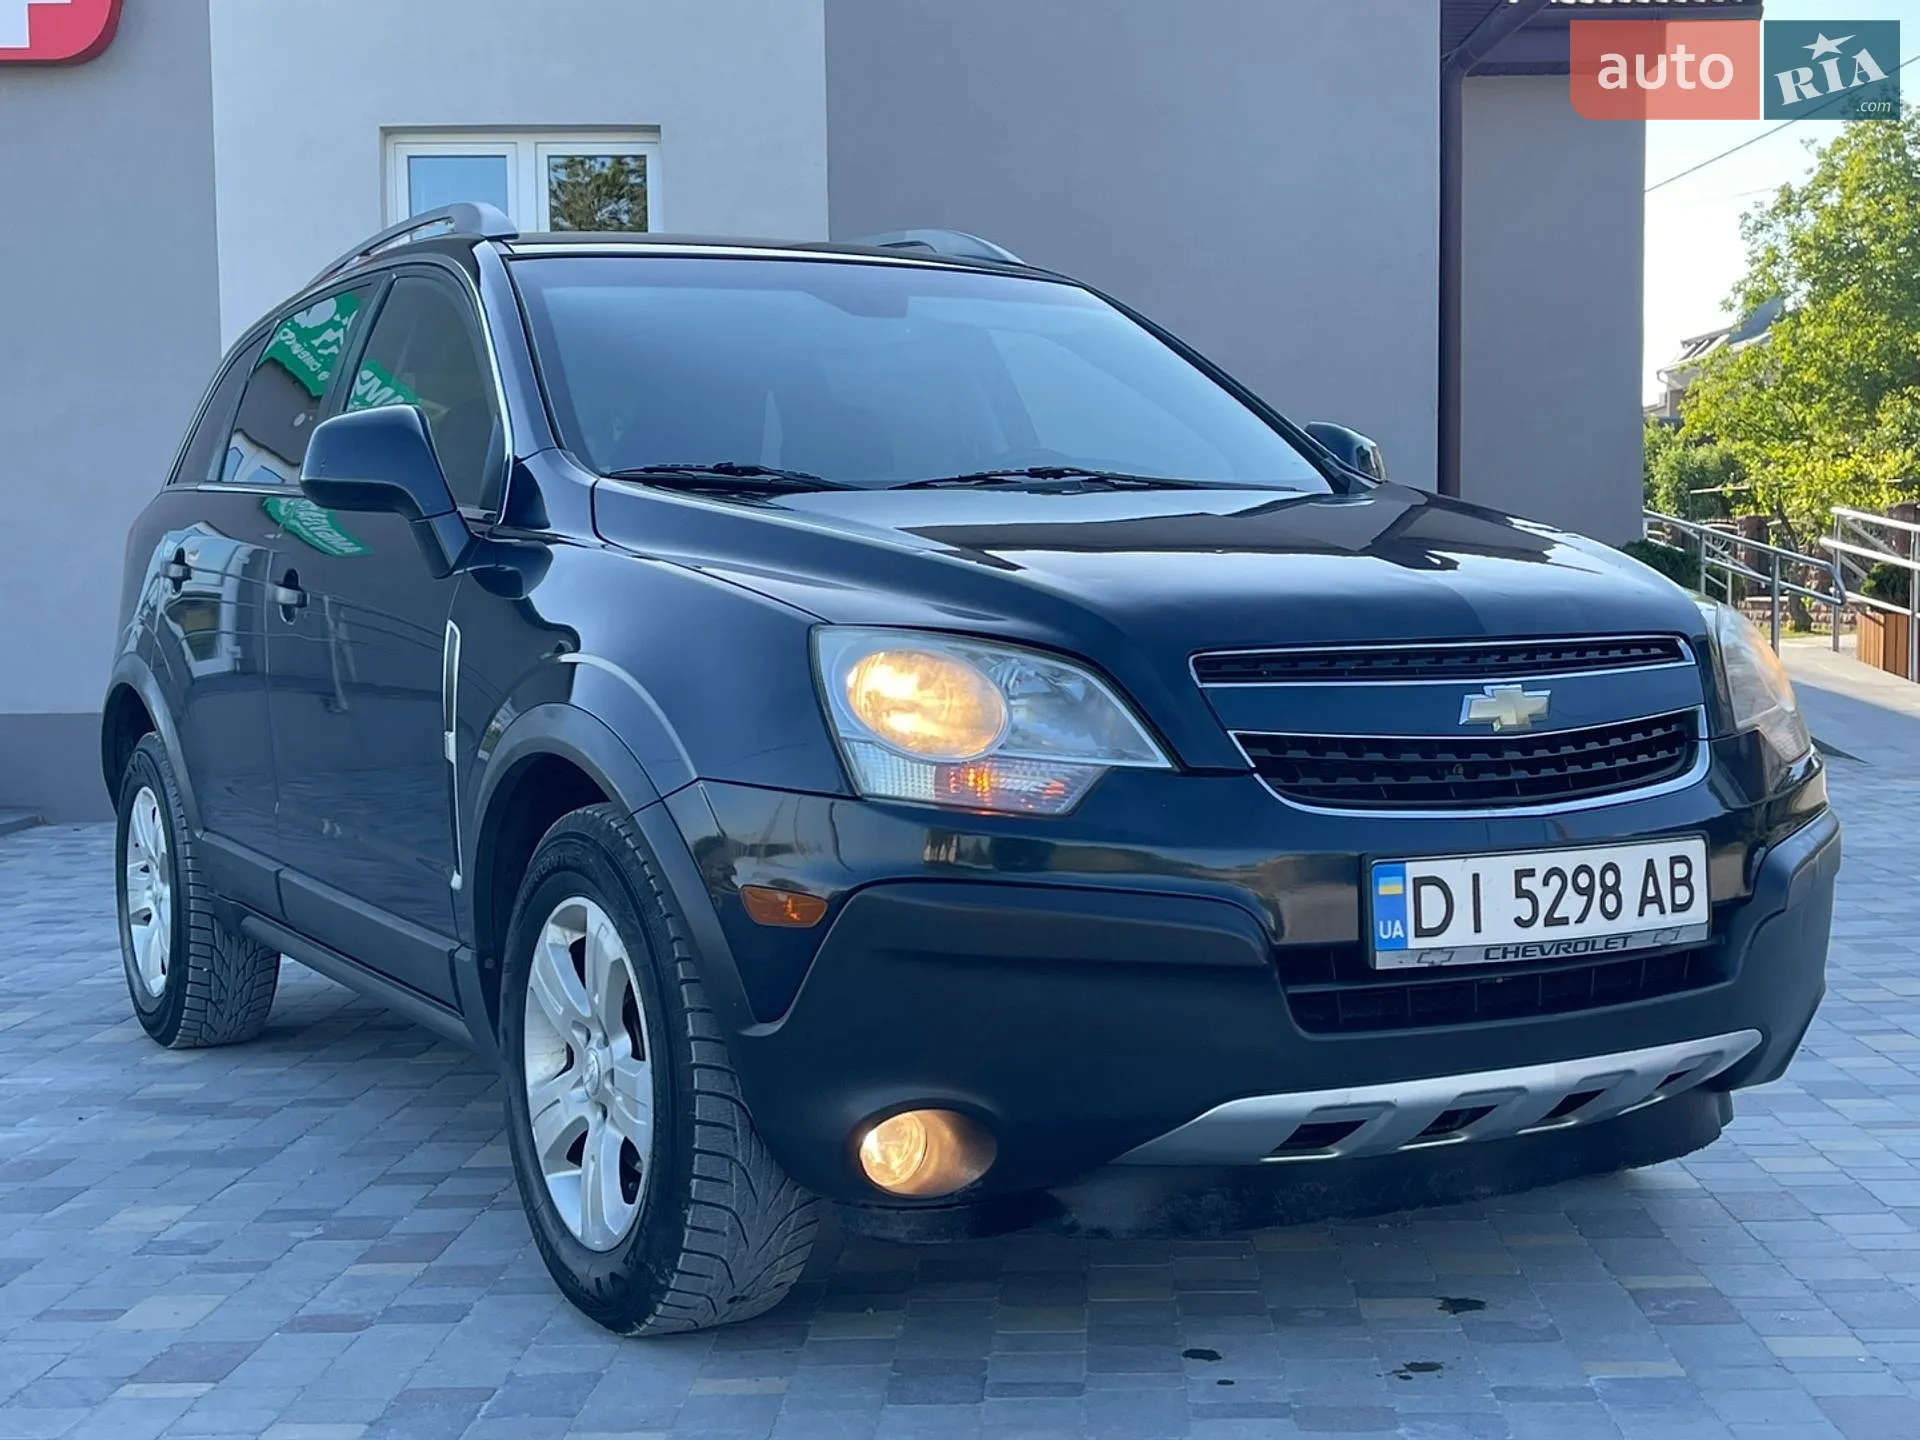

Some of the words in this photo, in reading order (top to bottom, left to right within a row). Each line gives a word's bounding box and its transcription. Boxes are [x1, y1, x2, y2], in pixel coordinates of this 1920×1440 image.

[1412, 873, 1482, 938] DI
[1513, 862, 1622, 928] 5298
[1638, 855, 1695, 917] AB
[1379, 920, 1405, 939] UA
[1484, 935, 1632, 961] CHEVROLET
